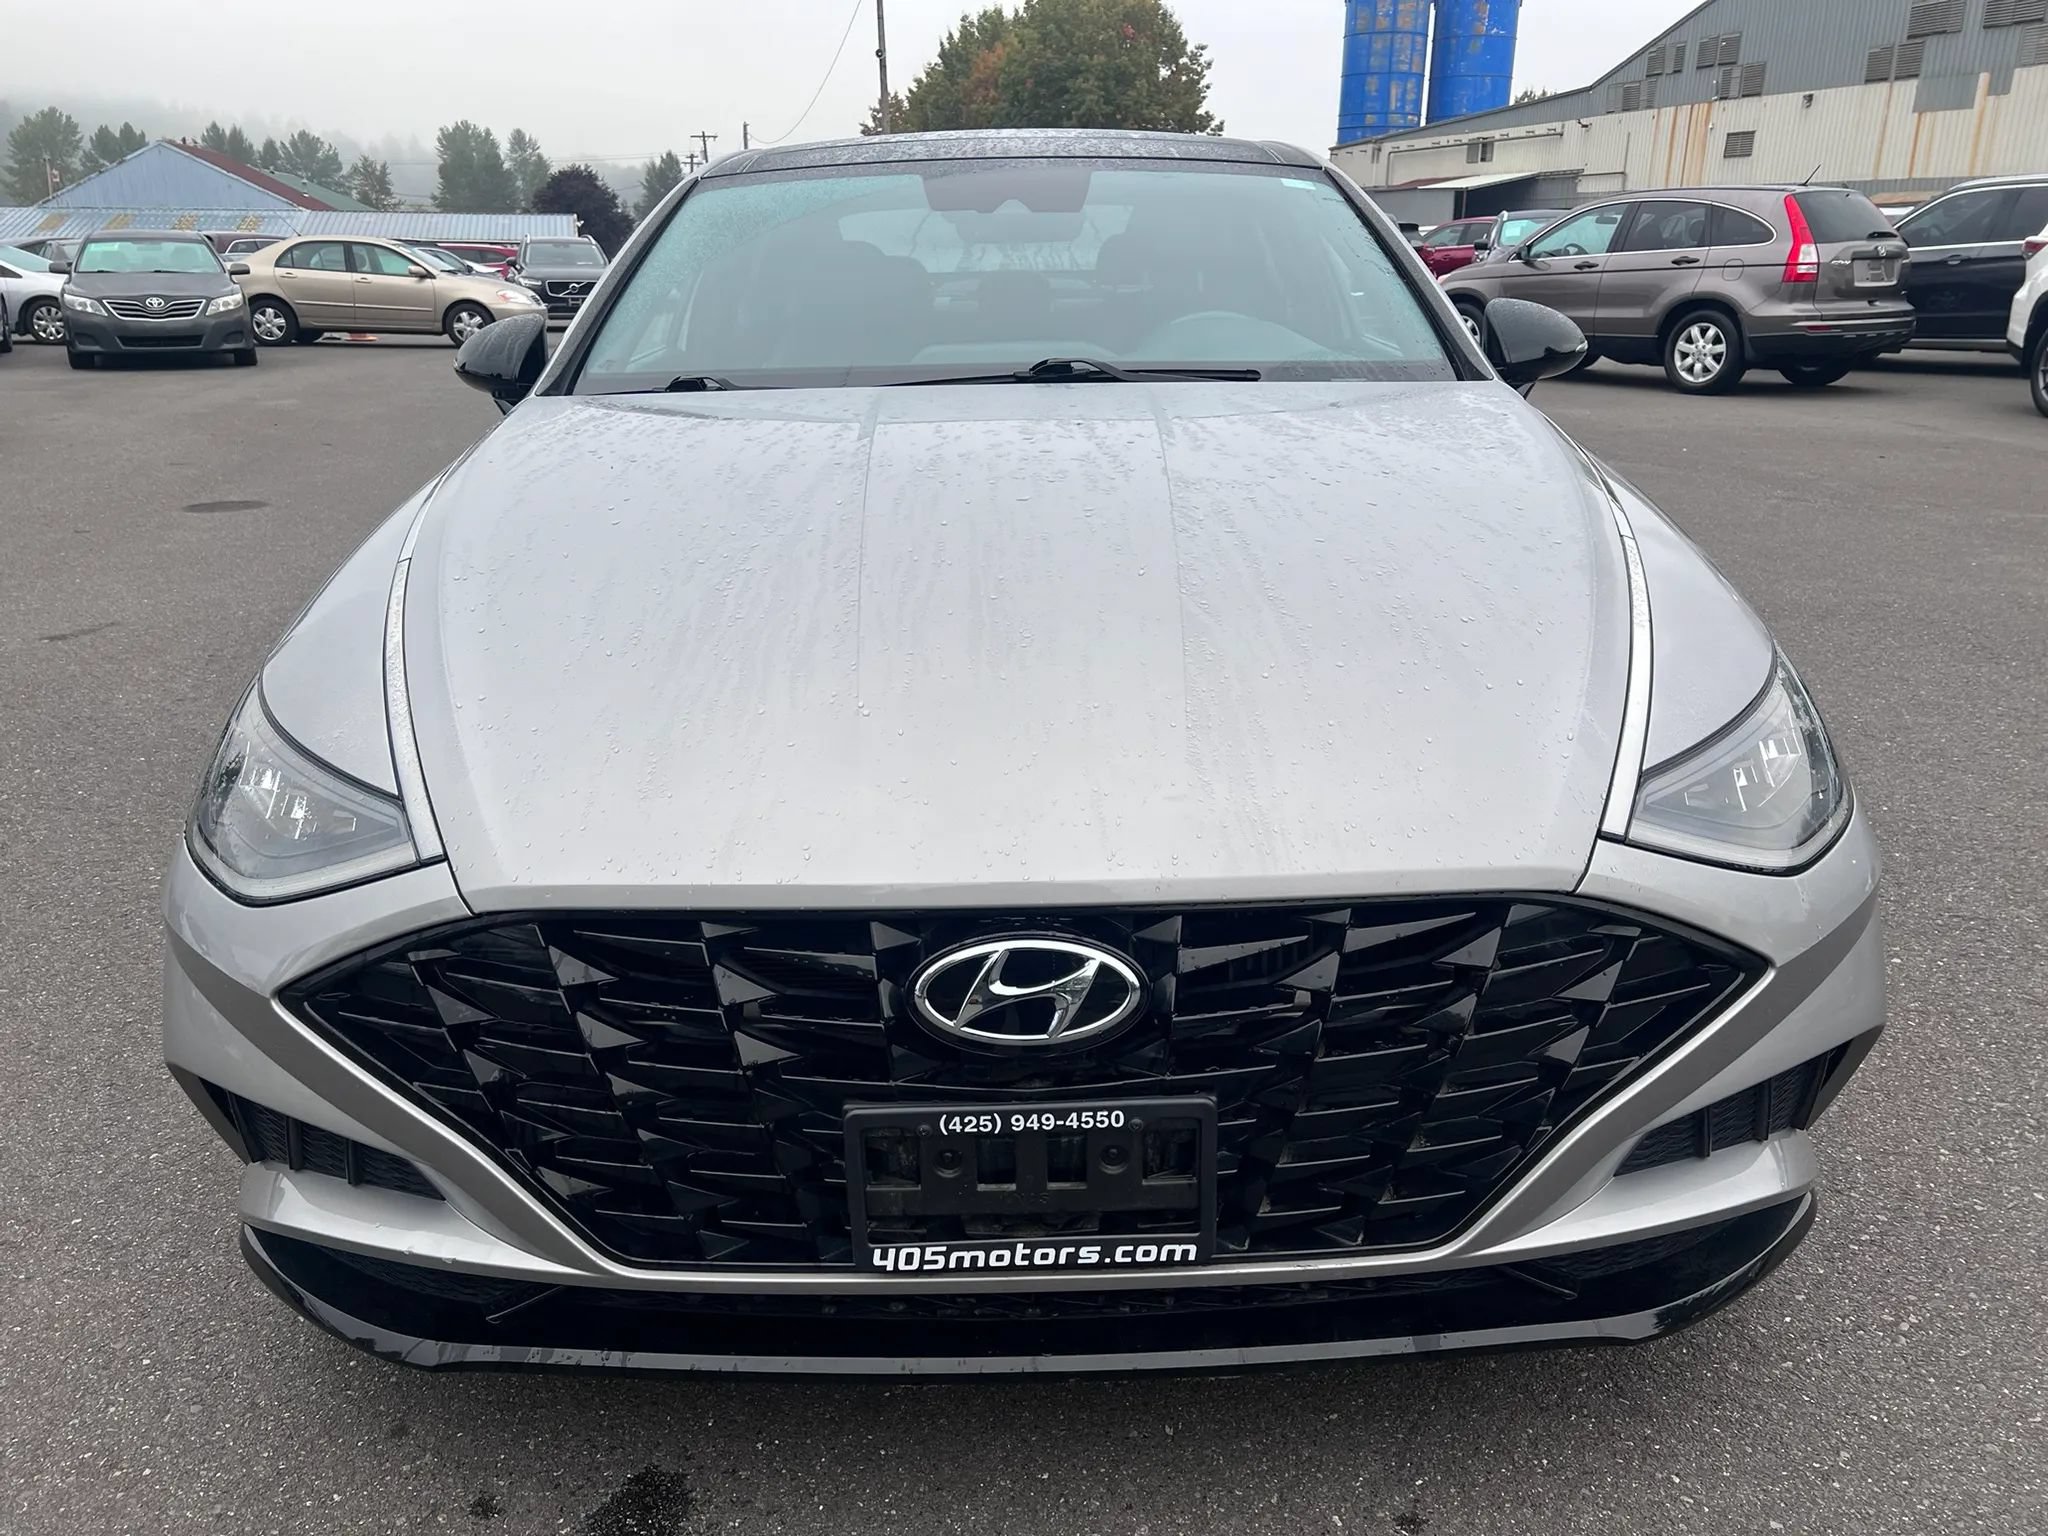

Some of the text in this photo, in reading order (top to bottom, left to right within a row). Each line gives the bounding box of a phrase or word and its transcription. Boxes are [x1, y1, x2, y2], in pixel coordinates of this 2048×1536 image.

[939, 1110, 1125, 1135] (425) 949-4550
[872, 1243, 1197, 1271] 405motors.com
